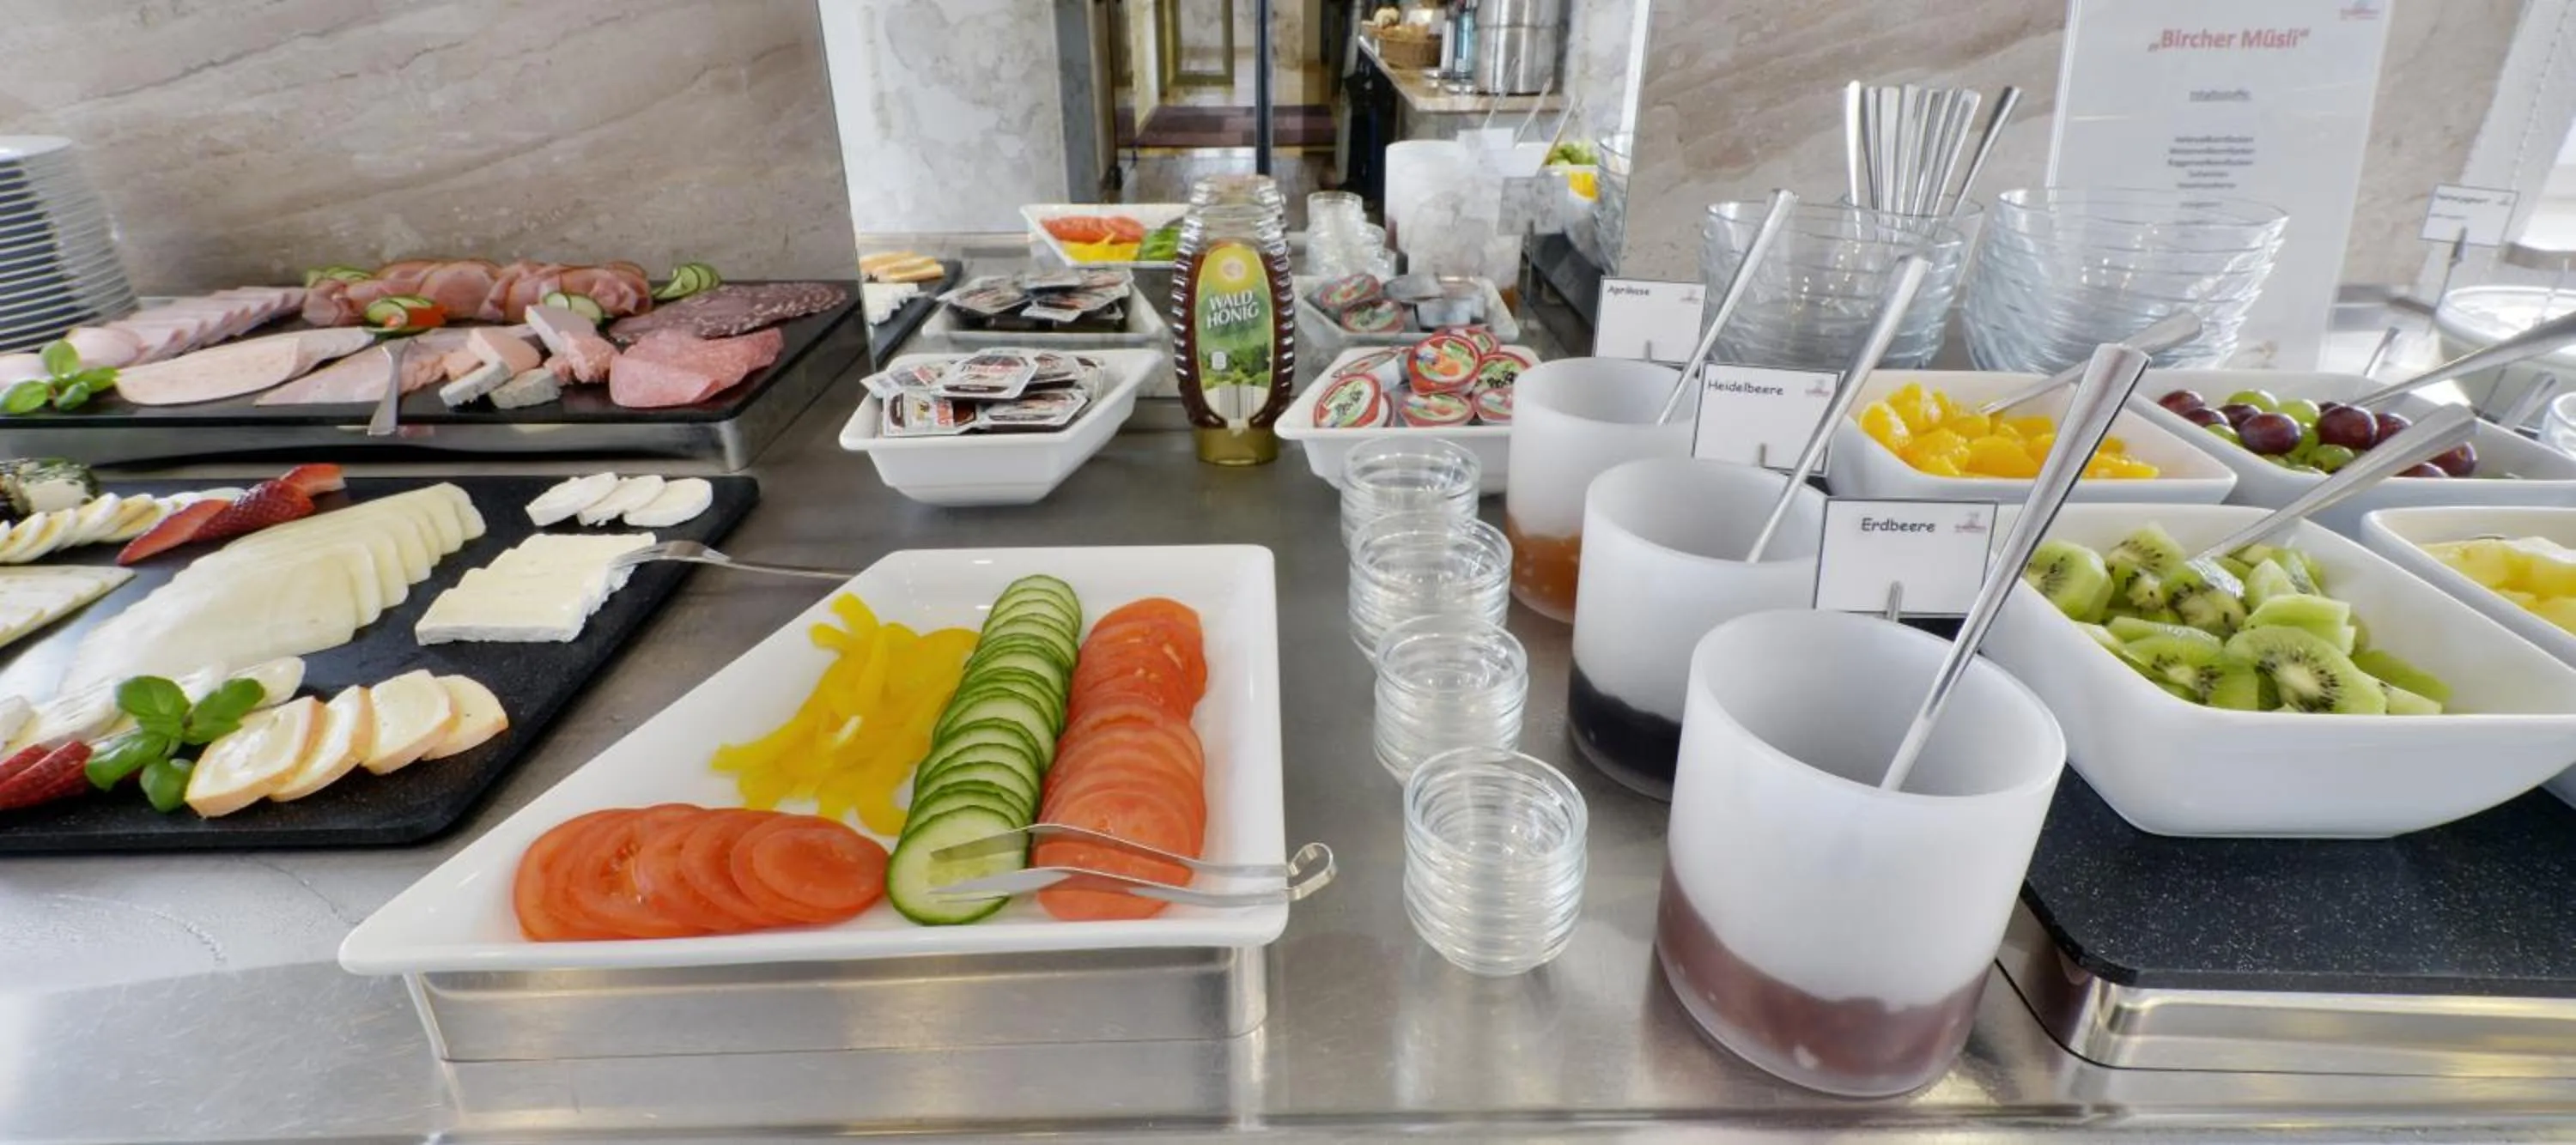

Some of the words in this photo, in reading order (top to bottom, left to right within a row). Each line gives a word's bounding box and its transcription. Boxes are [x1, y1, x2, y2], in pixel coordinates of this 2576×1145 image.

[2148, 28, 2235, 52] „Bircher
[1209, 290, 1253, 310] WALD
[1206, 301, 1260, 330] HONIG
[1708, 379, 1783, 396] Heidelbeere
[1861, 517, 1936, 532] Erdbeere
